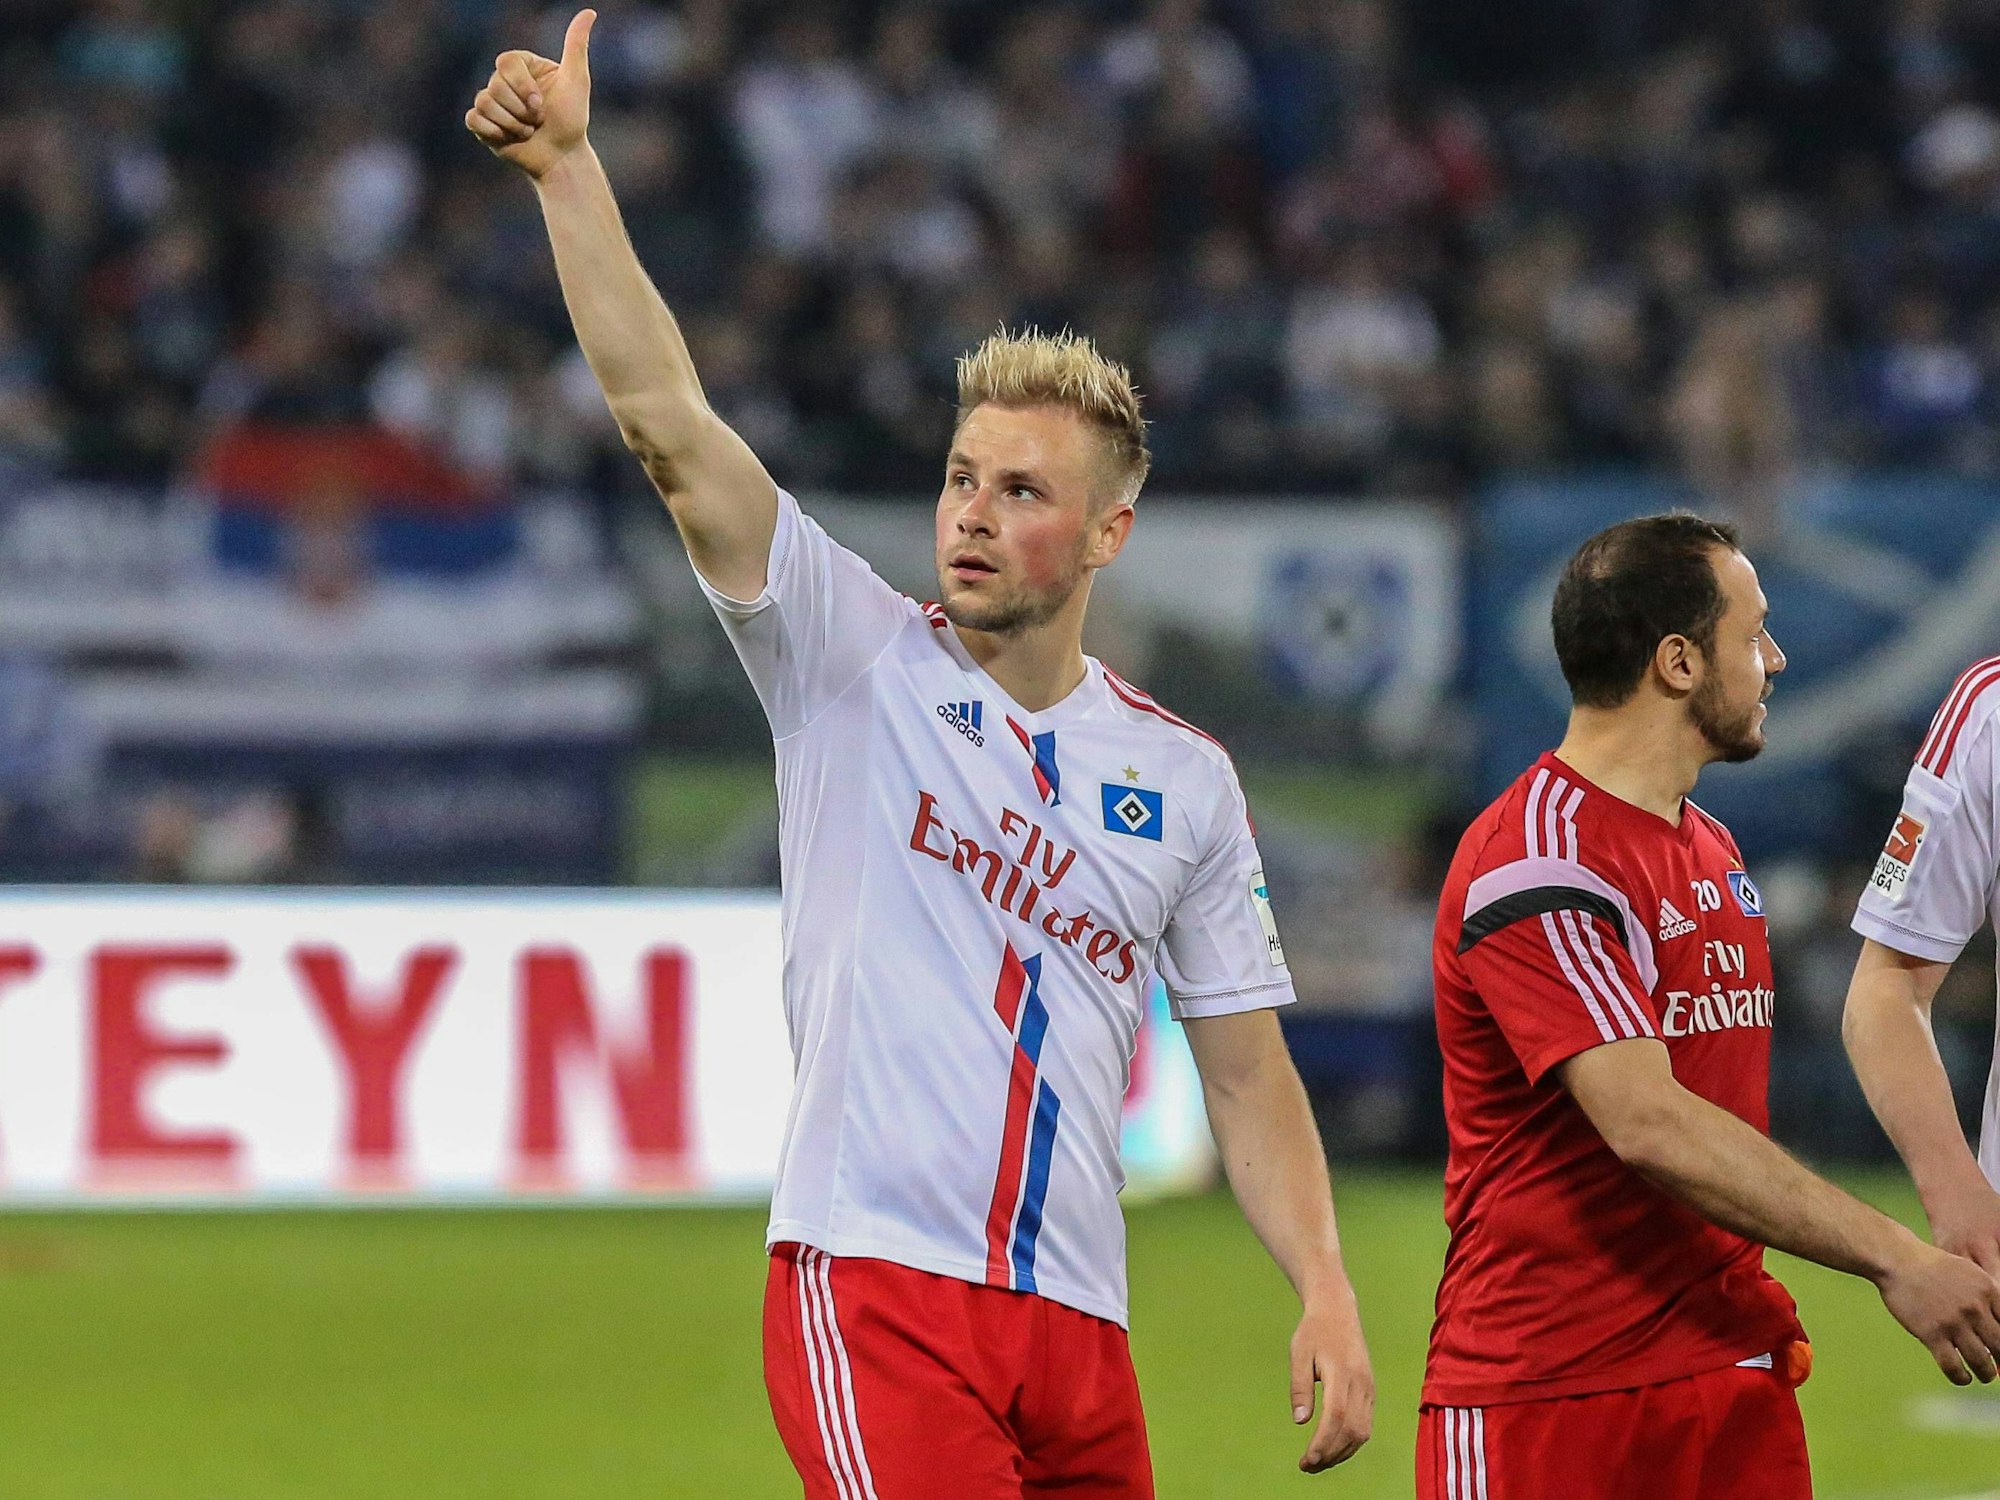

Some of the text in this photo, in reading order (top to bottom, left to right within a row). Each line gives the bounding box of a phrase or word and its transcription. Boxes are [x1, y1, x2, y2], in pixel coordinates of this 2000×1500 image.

[936, 704, 985, 748] adidas
[999, 806, 1077, 889] Fly
[909, 789, 1138, 984] Emirates
[1690, 879, 1722, 912] 20
[1869, 870, 1893, 892] IGA
[1658, 918, 1697, 942] adidas
[1703, 939, 1745, 979] Fly
[0, 942, 694, 1172] EYN
